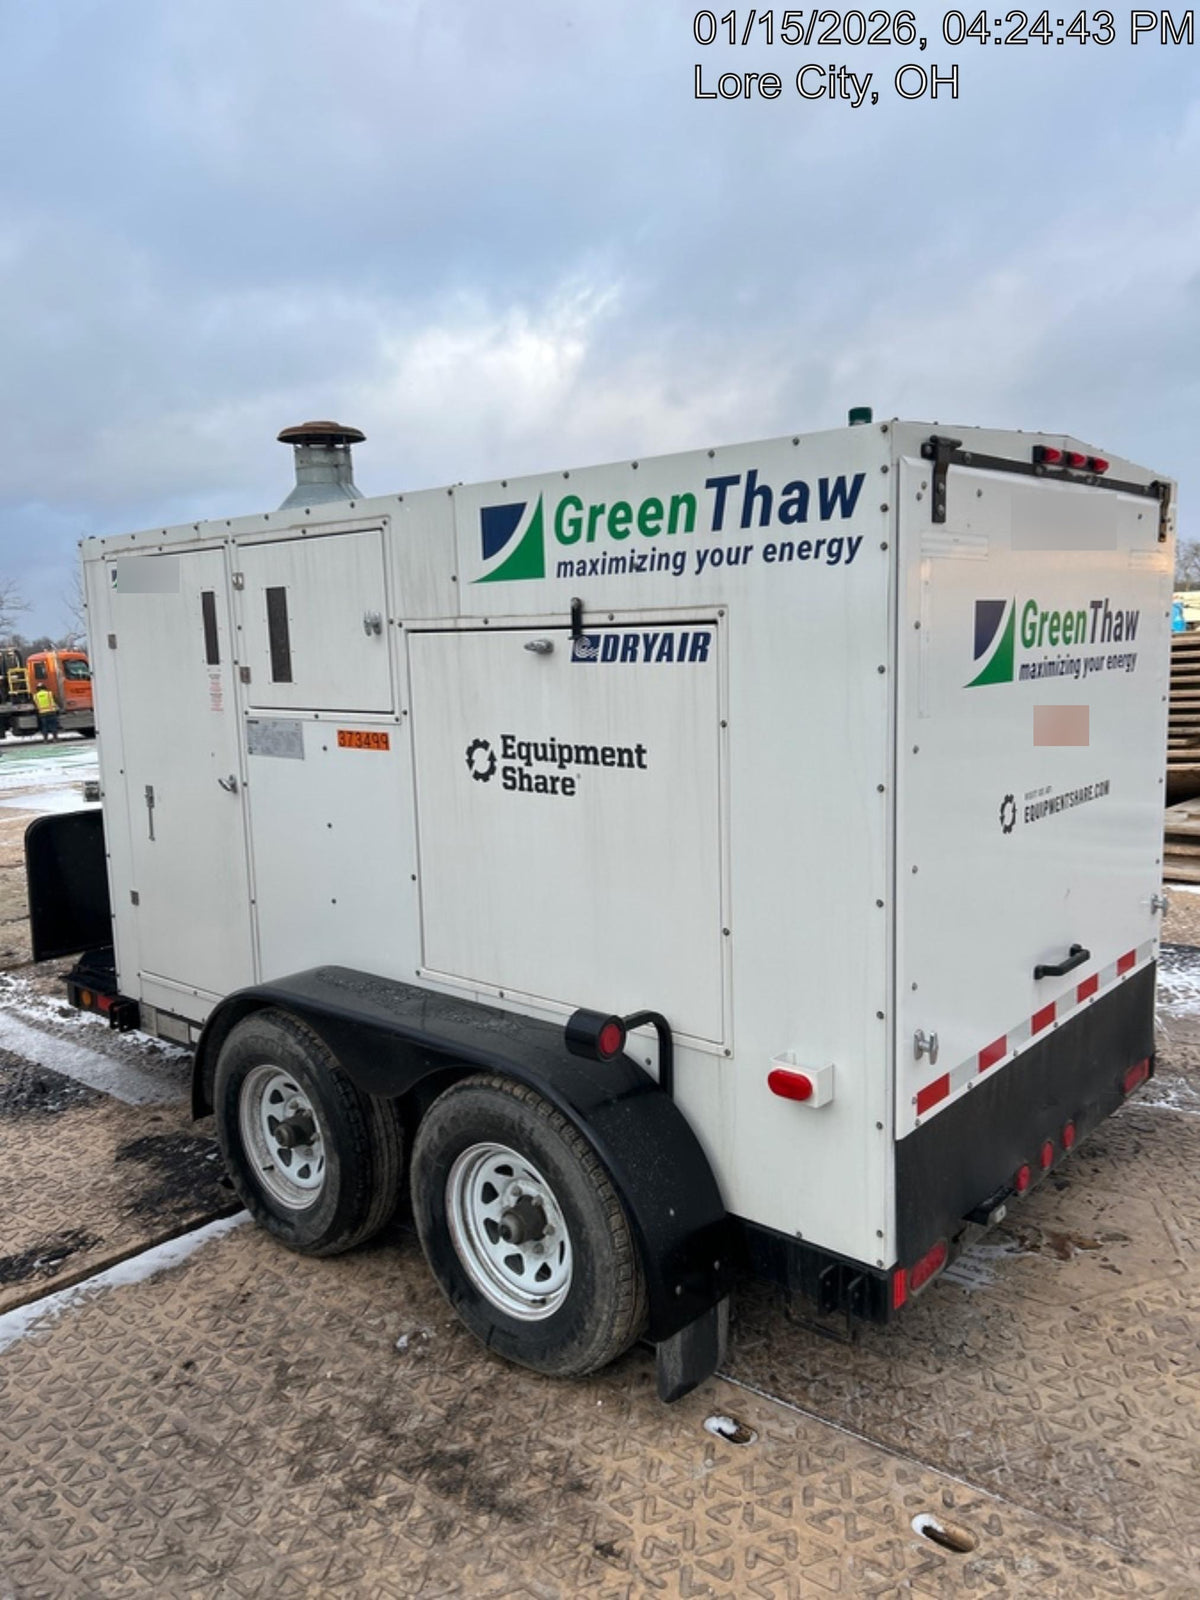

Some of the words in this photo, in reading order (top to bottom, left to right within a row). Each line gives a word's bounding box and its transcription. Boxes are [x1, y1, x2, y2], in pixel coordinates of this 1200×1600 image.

[556, 547, 687, 578] maximizing
[695, 544, 754, 575] your
[762, 535, 863, 565] energy
[600, 632, 712, 663] DRYAIR
[1018, 653, 1082, 681] maximizing
[1082, 655, 1105, 679] your
[1106, 652, 1138, 674] energy
[337, 730, 390, 751] 373499
[500, 734, 648, 770] Equipment
[502, 765, 576, 797] Share
